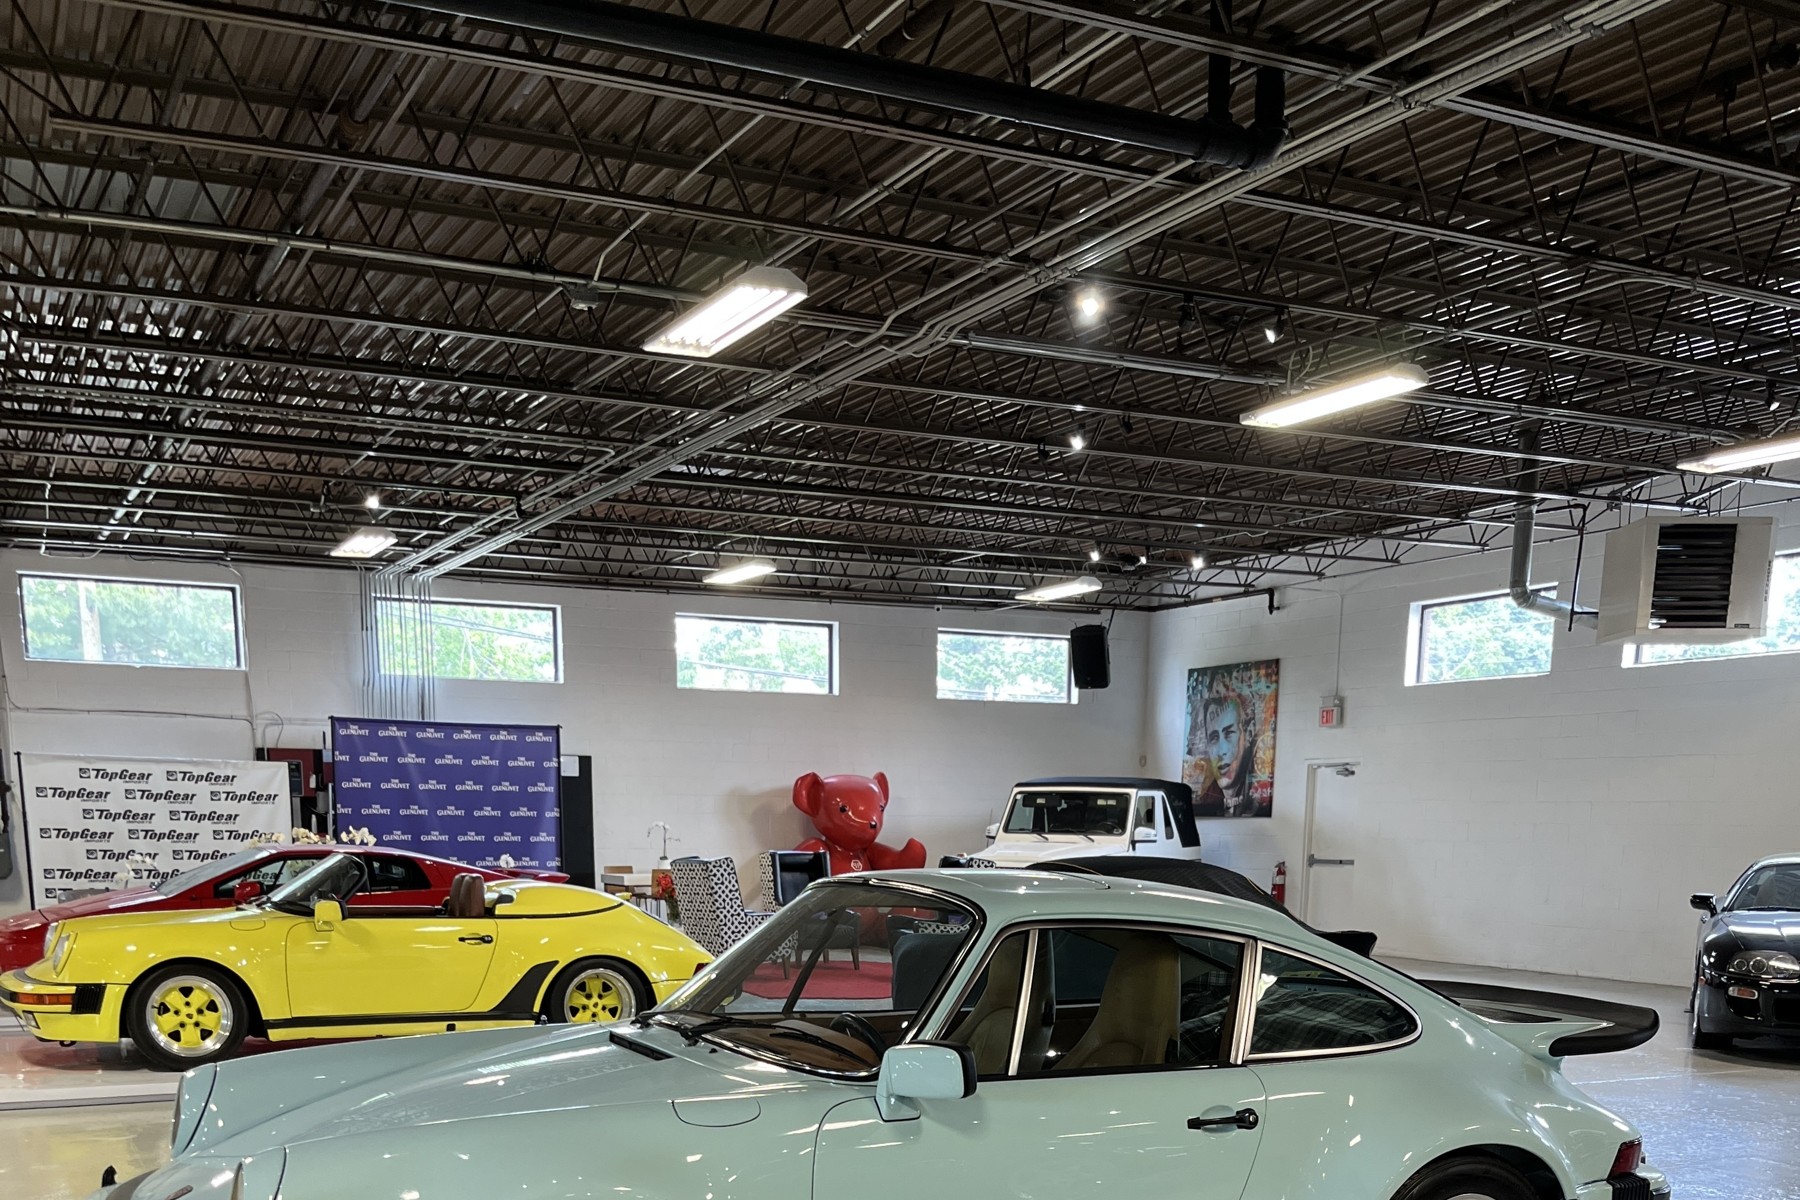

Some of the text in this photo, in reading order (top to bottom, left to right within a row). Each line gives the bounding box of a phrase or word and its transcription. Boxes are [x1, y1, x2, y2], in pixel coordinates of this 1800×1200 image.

[1321, 709, 1334, 724] EXIT
[92, 768, 152, 781] TopGear
[179, 771, 237, 784] TopGear
[48, 787, 111, 800] TopGear
[137, 789, 196, 802] TopGear
[222, 791, 278, 803] TopGear
[95, 809, 155, 822] TopGear
[181, 811, 240, 823] TopGear
[52, 828, 114, 841] TopGear
[140, 829, 199, 842] TopGear
